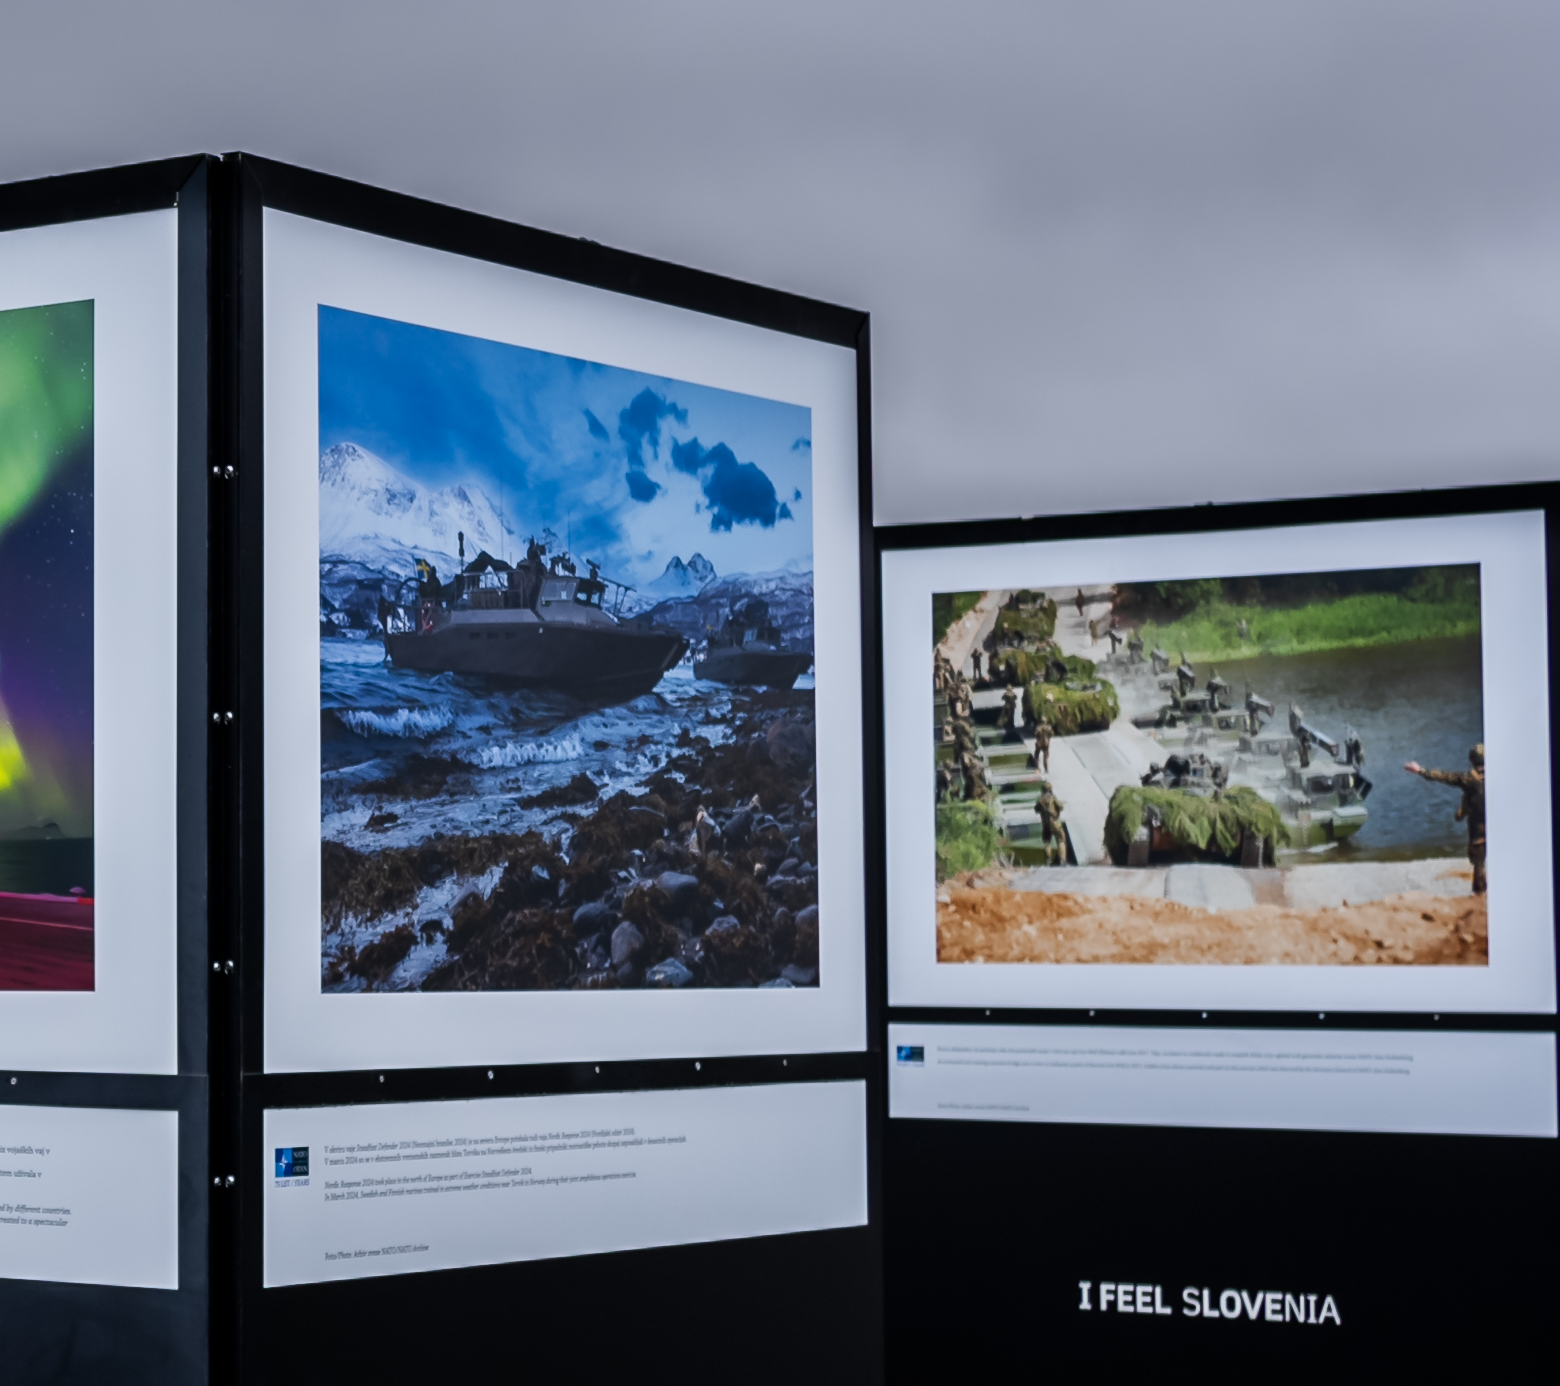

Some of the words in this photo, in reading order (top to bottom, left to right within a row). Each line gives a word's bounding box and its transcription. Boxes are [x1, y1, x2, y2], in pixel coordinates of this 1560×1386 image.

[1079, 1282, 1091, 1310] I
[1100, 1283, 1172, 1314] FEEL
[1183, 1288, 1340, 1325] SLOVENIA
